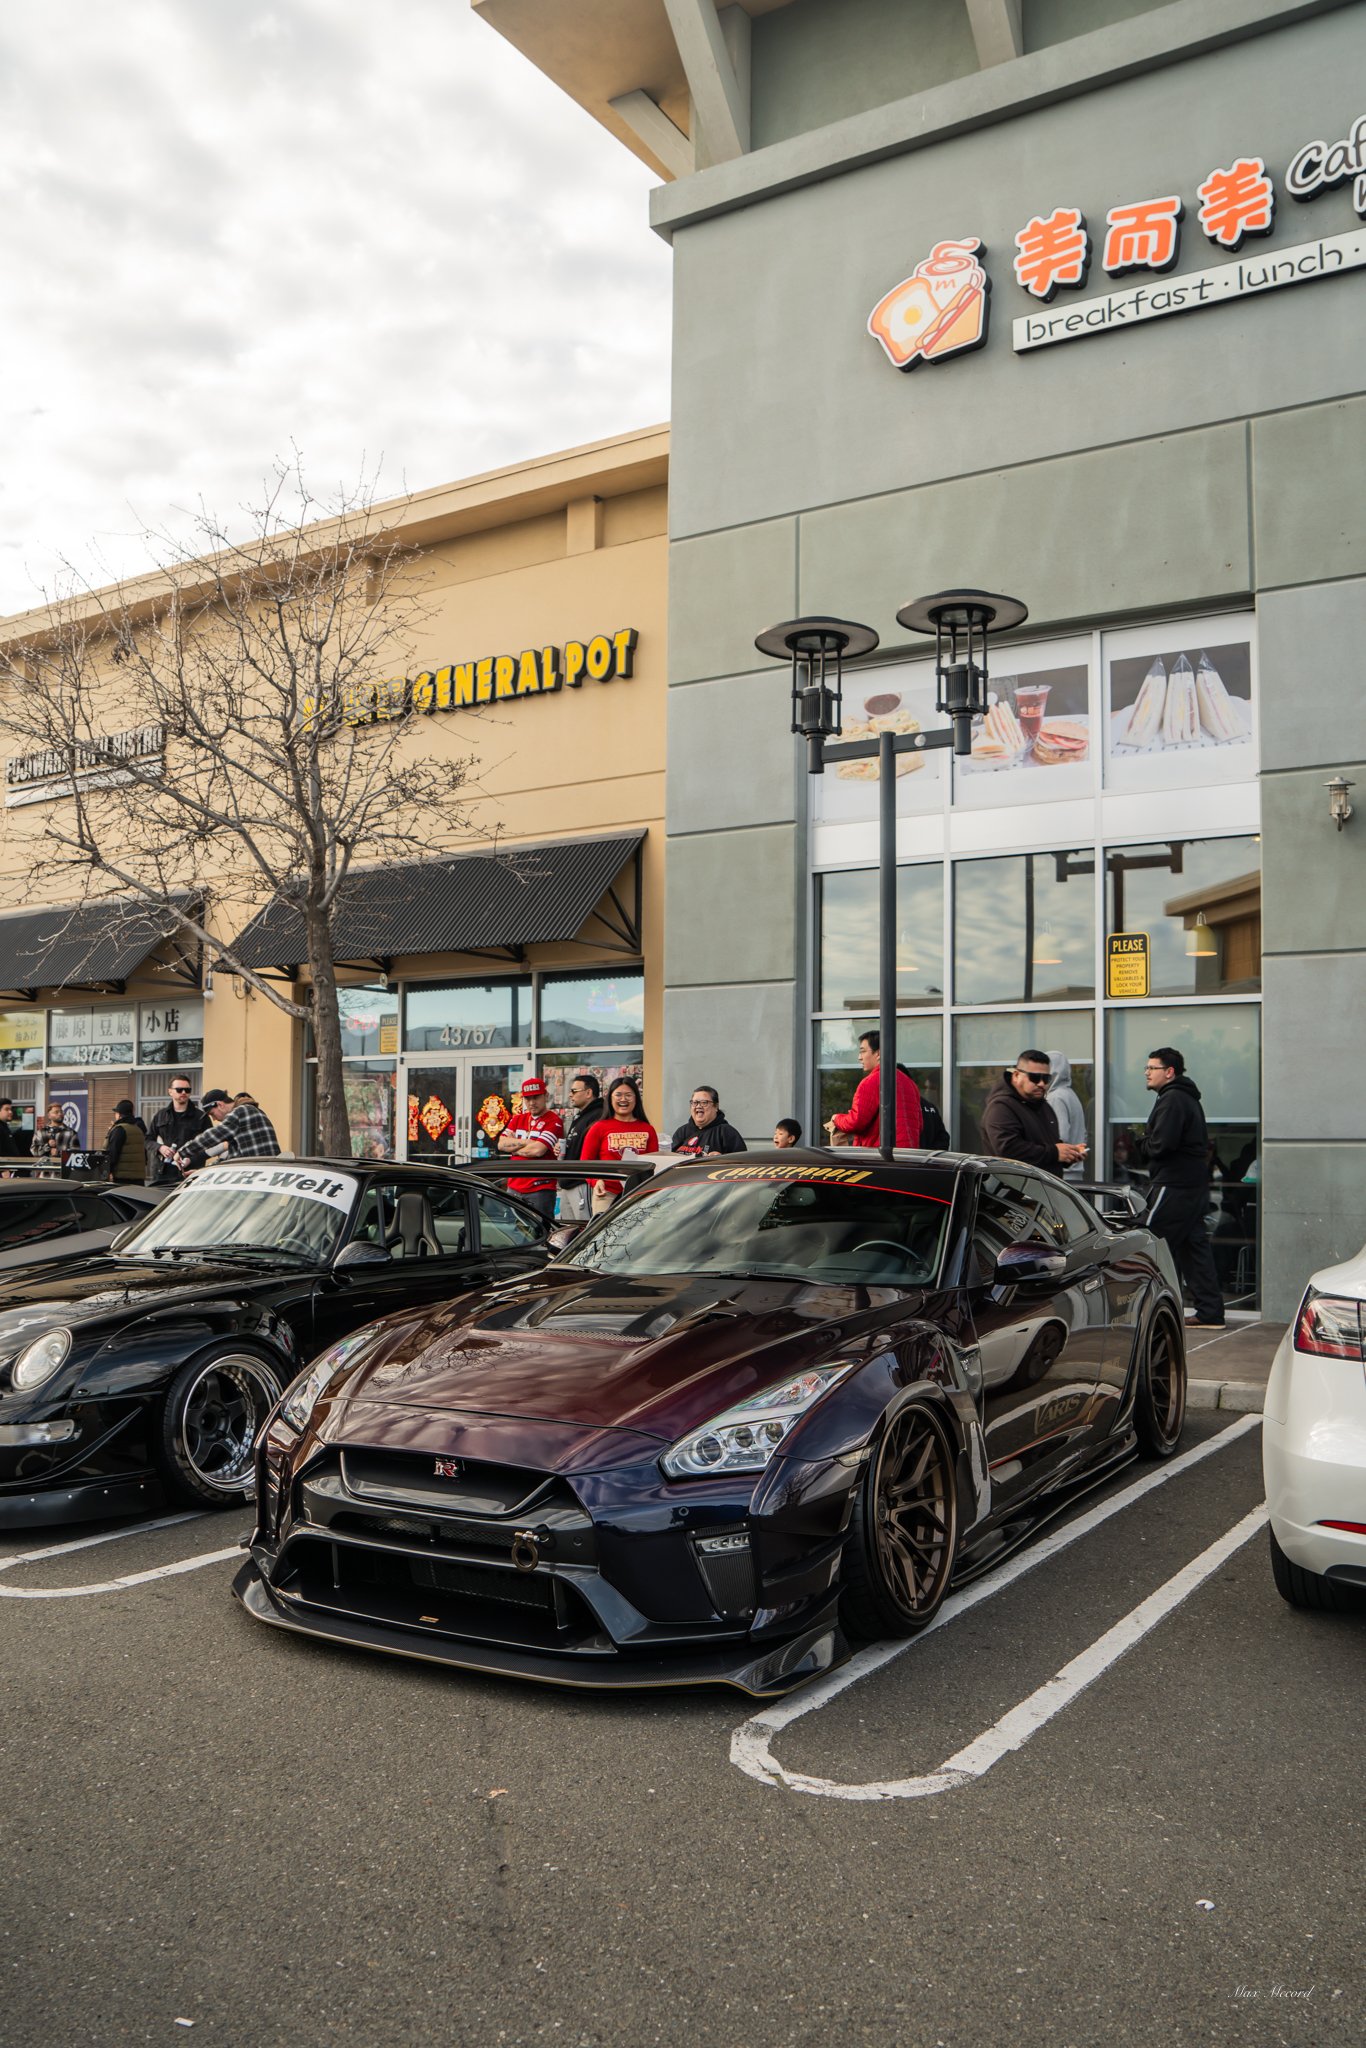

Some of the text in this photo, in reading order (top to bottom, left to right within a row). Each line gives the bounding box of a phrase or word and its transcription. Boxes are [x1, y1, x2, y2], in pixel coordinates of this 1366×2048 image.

[1013, 157, 1274, 299] 美而美
[1026, 243, 1344, 343] breakfast lunch
[412, 647, 560, 714] GENERAL
[564, 628, 638, 688] POT
[1112, 939, 1144, 953] PLEASE
[439, 1024, 497, 1047] 43767
[73, 1045, 111, 1063] 43773
[610, 1138, 648, 1149] 49ERS
[721, 1165, 861, 1181] BULLETPROOF
[1034, 1394, 1081, 1435] VARIS
